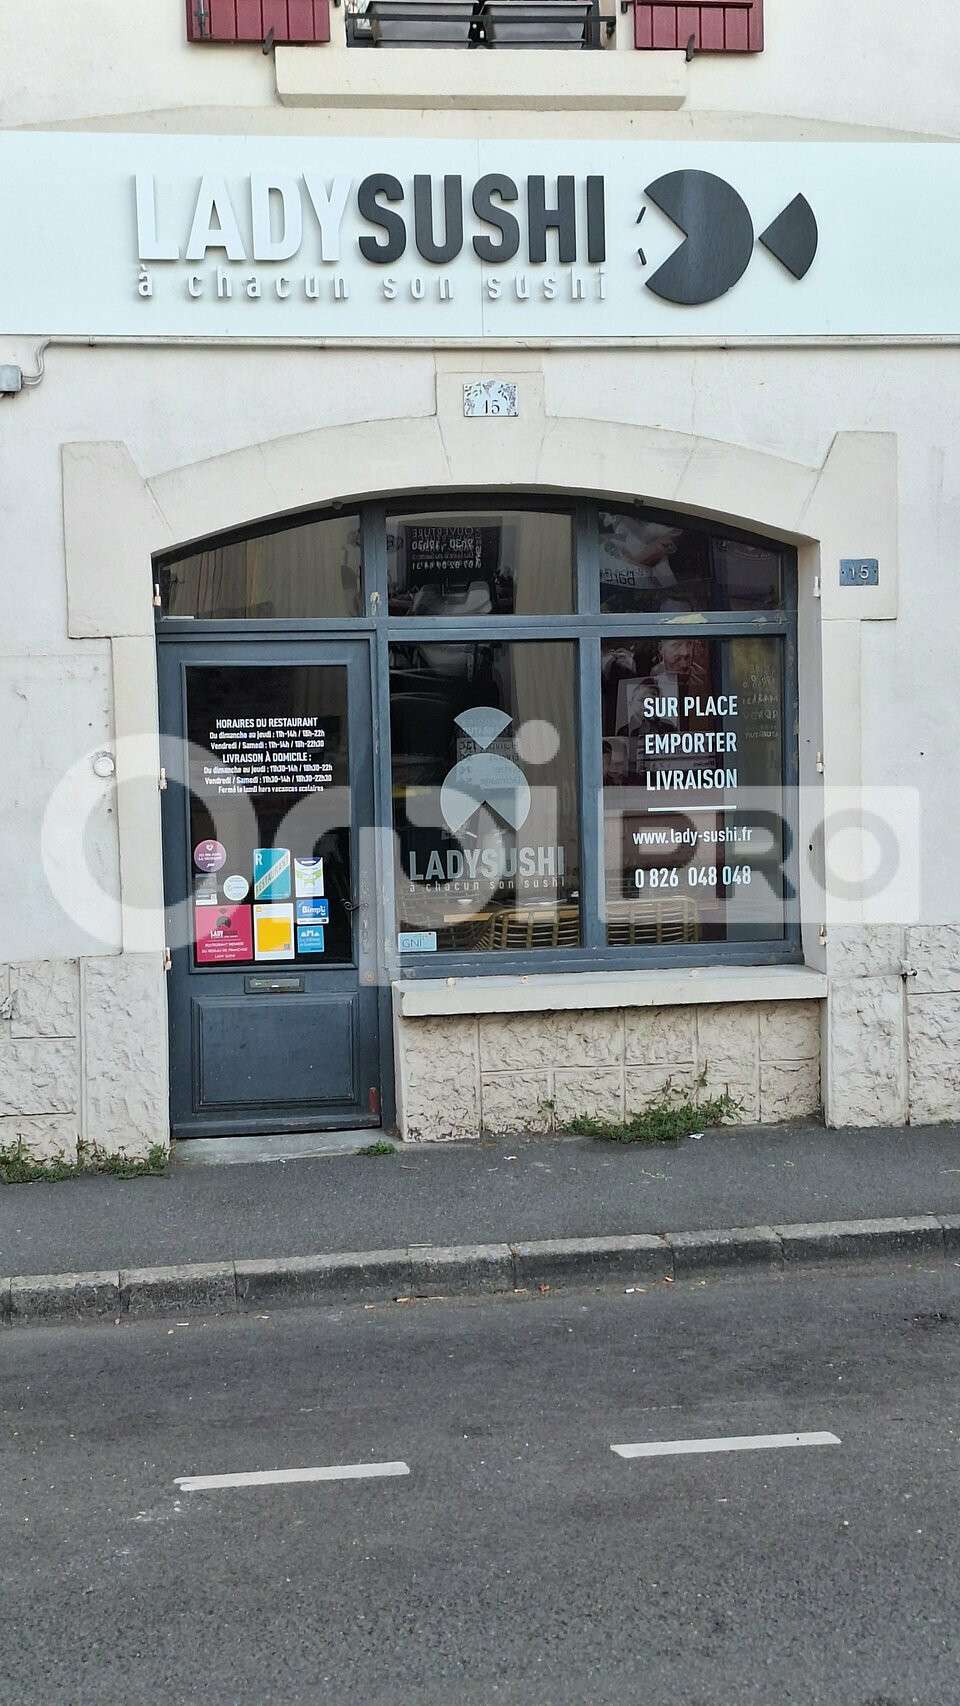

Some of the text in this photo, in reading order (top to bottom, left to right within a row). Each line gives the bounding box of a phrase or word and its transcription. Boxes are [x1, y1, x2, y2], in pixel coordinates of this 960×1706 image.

[138, 264, 606, 301] à chacun son sushi
[485, 399, 500, 414] 15
[850, 565, 869, 579] 15
[643, 696, 678, 718] SUR
[684, 695, 738, 717] PLACE
[216, 717, 318, 729] HORAIRES DU RESTAURANT
[645, 732, 737, 754] EMPORTER
[222, 753, 264, 763] LIVRAISON
[265, 750, 272, 762] À
[272, 752, 308, 762] DOMICILE
[646, 768, 738, 790] LIVRAISON
[632, 826, 752, 846] www.lady-sushi.fr
[426, 880, 480, 893] chacun
[490, 880, 514, 890] son
[524, 877, 565, 889] sushi
[634, 865, 751, 889] 0 826 048 048
